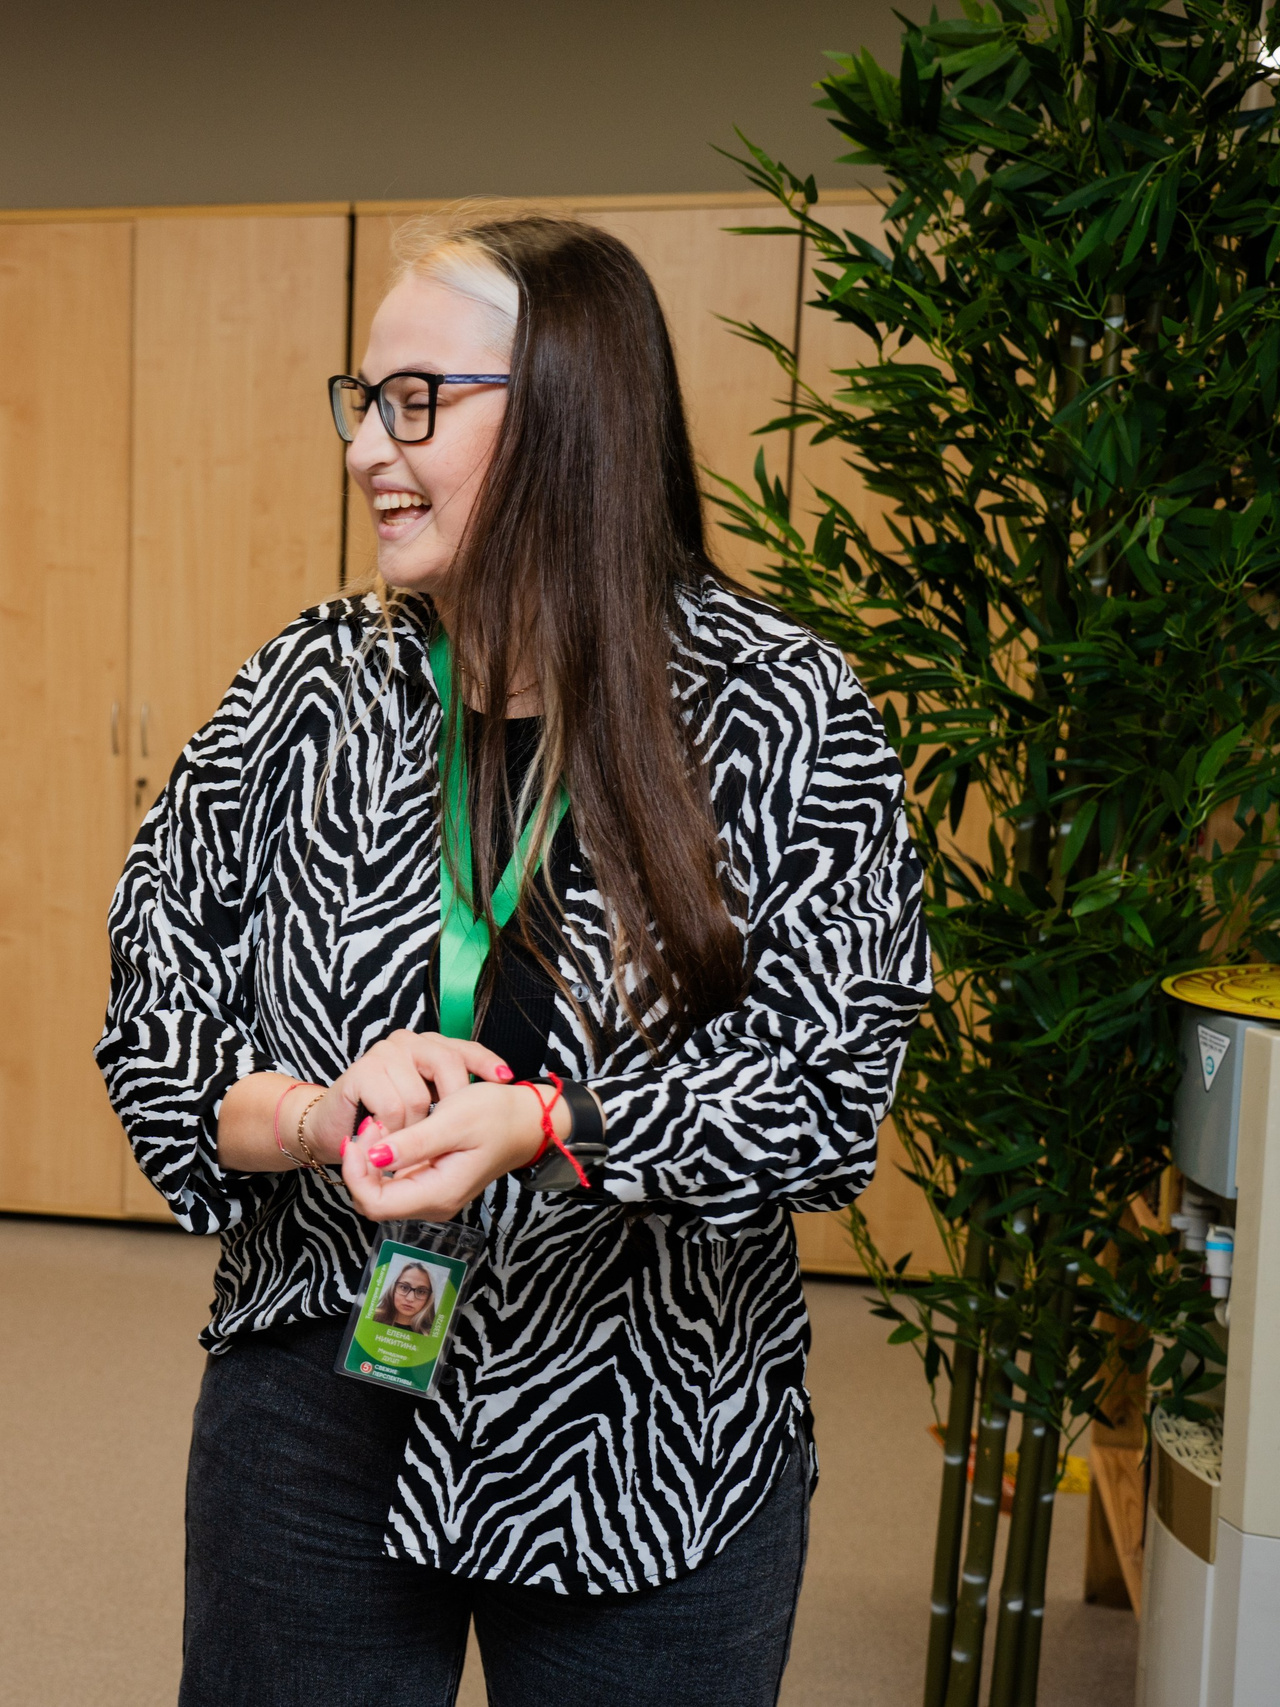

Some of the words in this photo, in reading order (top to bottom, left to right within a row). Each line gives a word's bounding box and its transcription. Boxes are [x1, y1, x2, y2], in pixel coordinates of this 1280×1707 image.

[386, 1328, 411, 1341] ЕЛЕНА
[374, 1334, 417, 1351] НИКИТИНА
[374, 1364, 399, 1375] СВЕЖИЕ
[372, 1370, 413, 1386] ПЕРСПЕКТИВЫ
